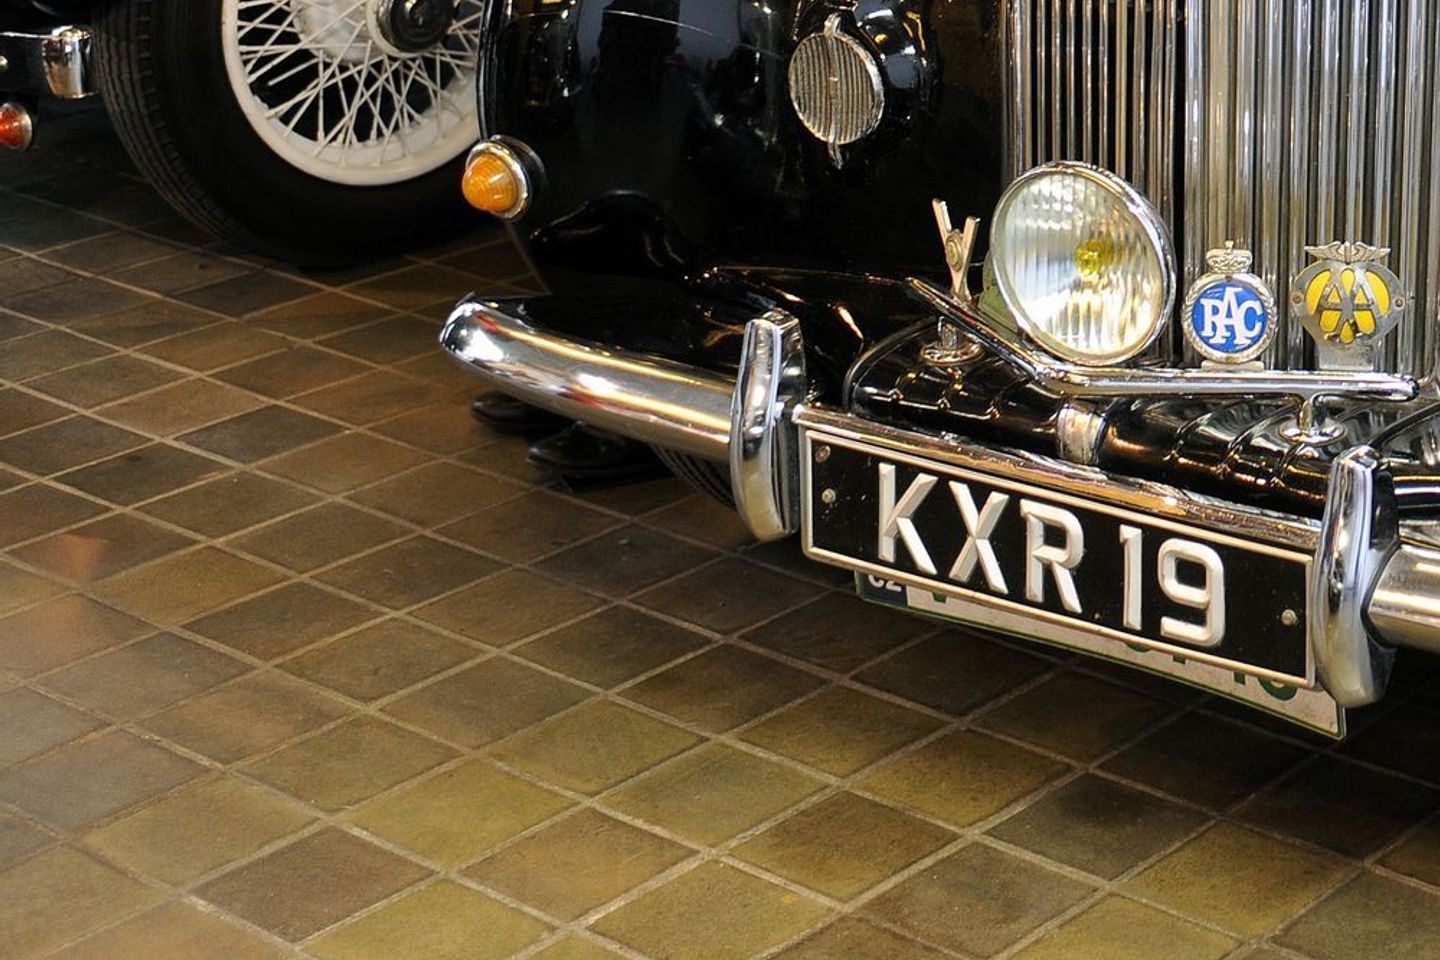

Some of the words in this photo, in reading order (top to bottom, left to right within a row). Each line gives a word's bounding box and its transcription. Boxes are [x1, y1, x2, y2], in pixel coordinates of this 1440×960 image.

[1200, 287, 1263, 344] RAC
[1314, 266, 1378, 339] AA
[878, 462, 1084, 614] KXR
[1119, 524, 1225, 647] 19
